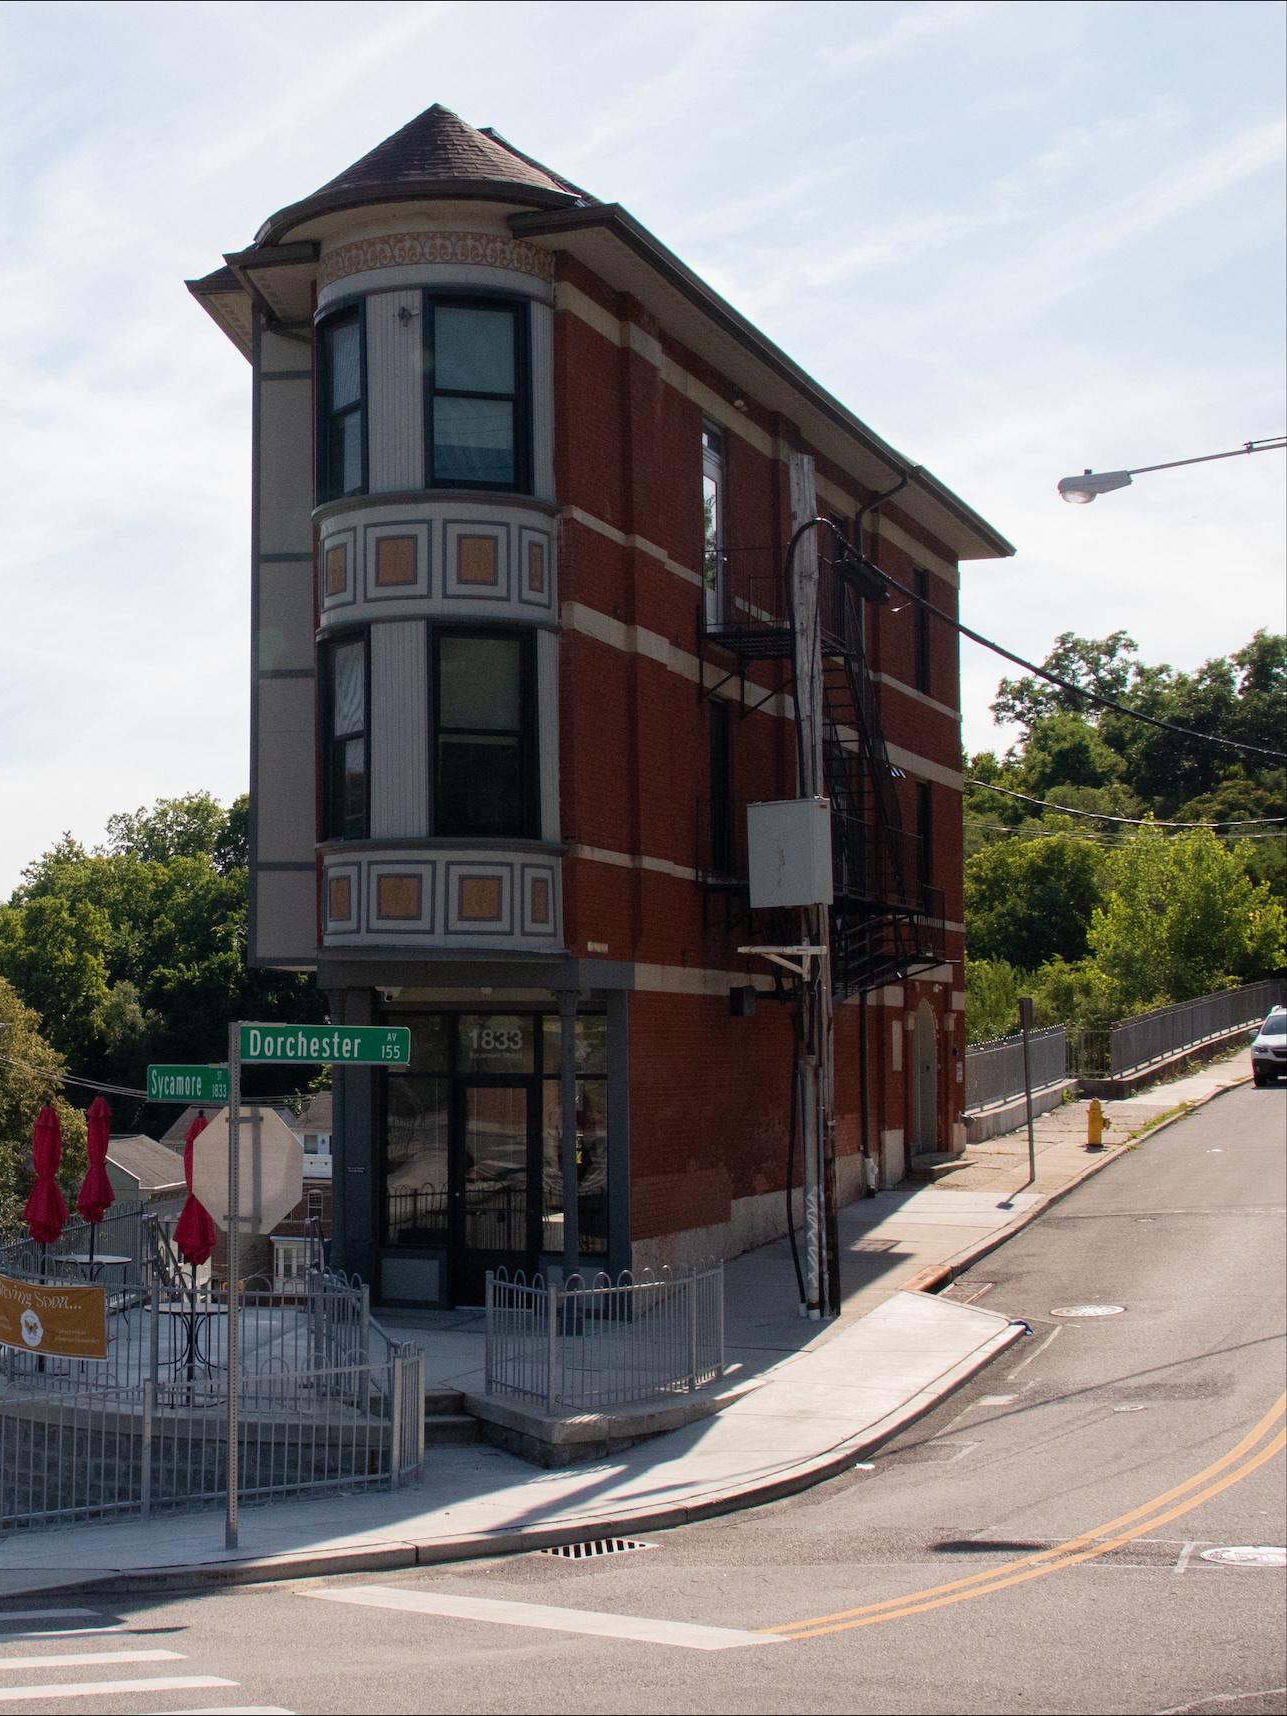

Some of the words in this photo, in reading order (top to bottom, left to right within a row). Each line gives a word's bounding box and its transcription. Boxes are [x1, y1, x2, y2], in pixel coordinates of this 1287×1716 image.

[249, 1029, 362, 1058] Dorchester
[386, 1032, 398, 1042] AV
[468, 1029, 524, 1050] 1833
[381, 1045, 401, 1059] 155
[469, 1052, 501, 1060] Sycamore
[216, 1070, 223, 1081] ST
[151, 1069, 202, 1099] Sycamore
[211, 1084, 227, 1098] 1833
[33, 1290, 82, 1310] Soon...
